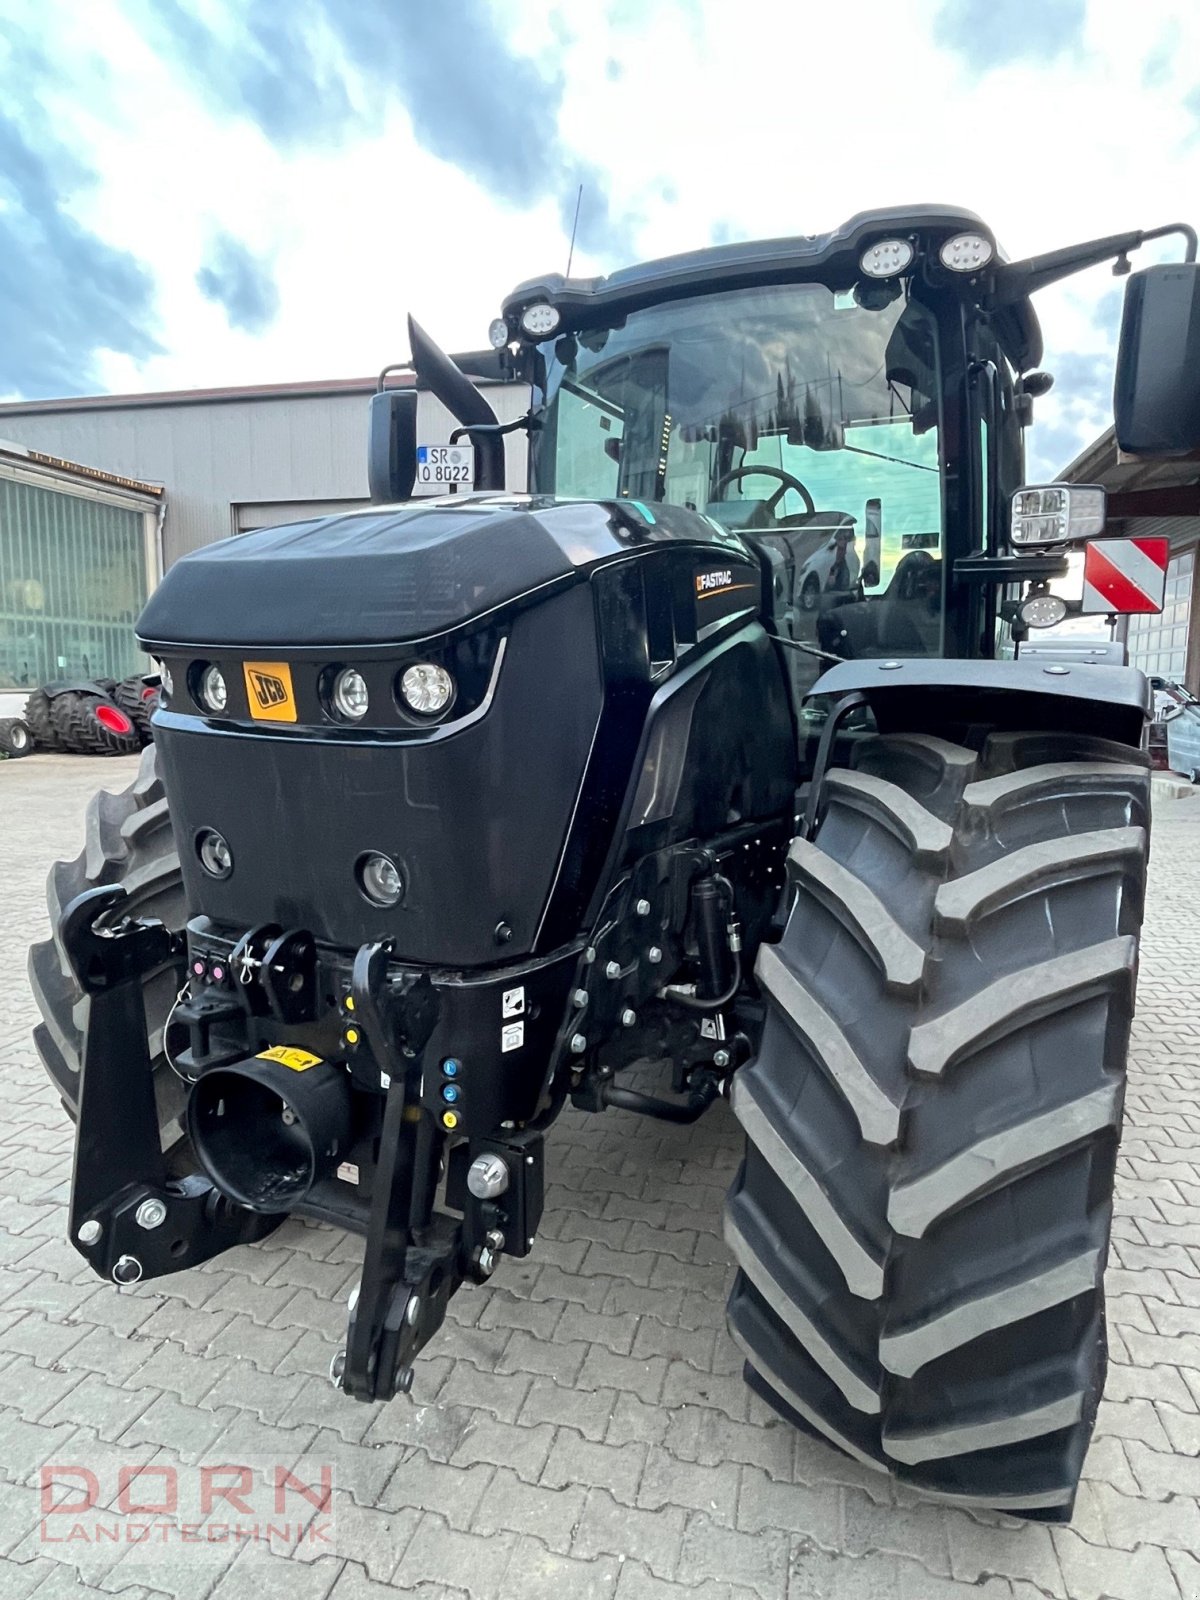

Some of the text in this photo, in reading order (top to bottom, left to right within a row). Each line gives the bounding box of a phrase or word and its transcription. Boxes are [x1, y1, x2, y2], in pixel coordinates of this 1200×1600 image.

[431, 449, 448, 464] SR
[435, 466, 469, 481] 8022
[701, 570, 732, 590] FASTRAC
[254, 674, 285, 705] JCB
